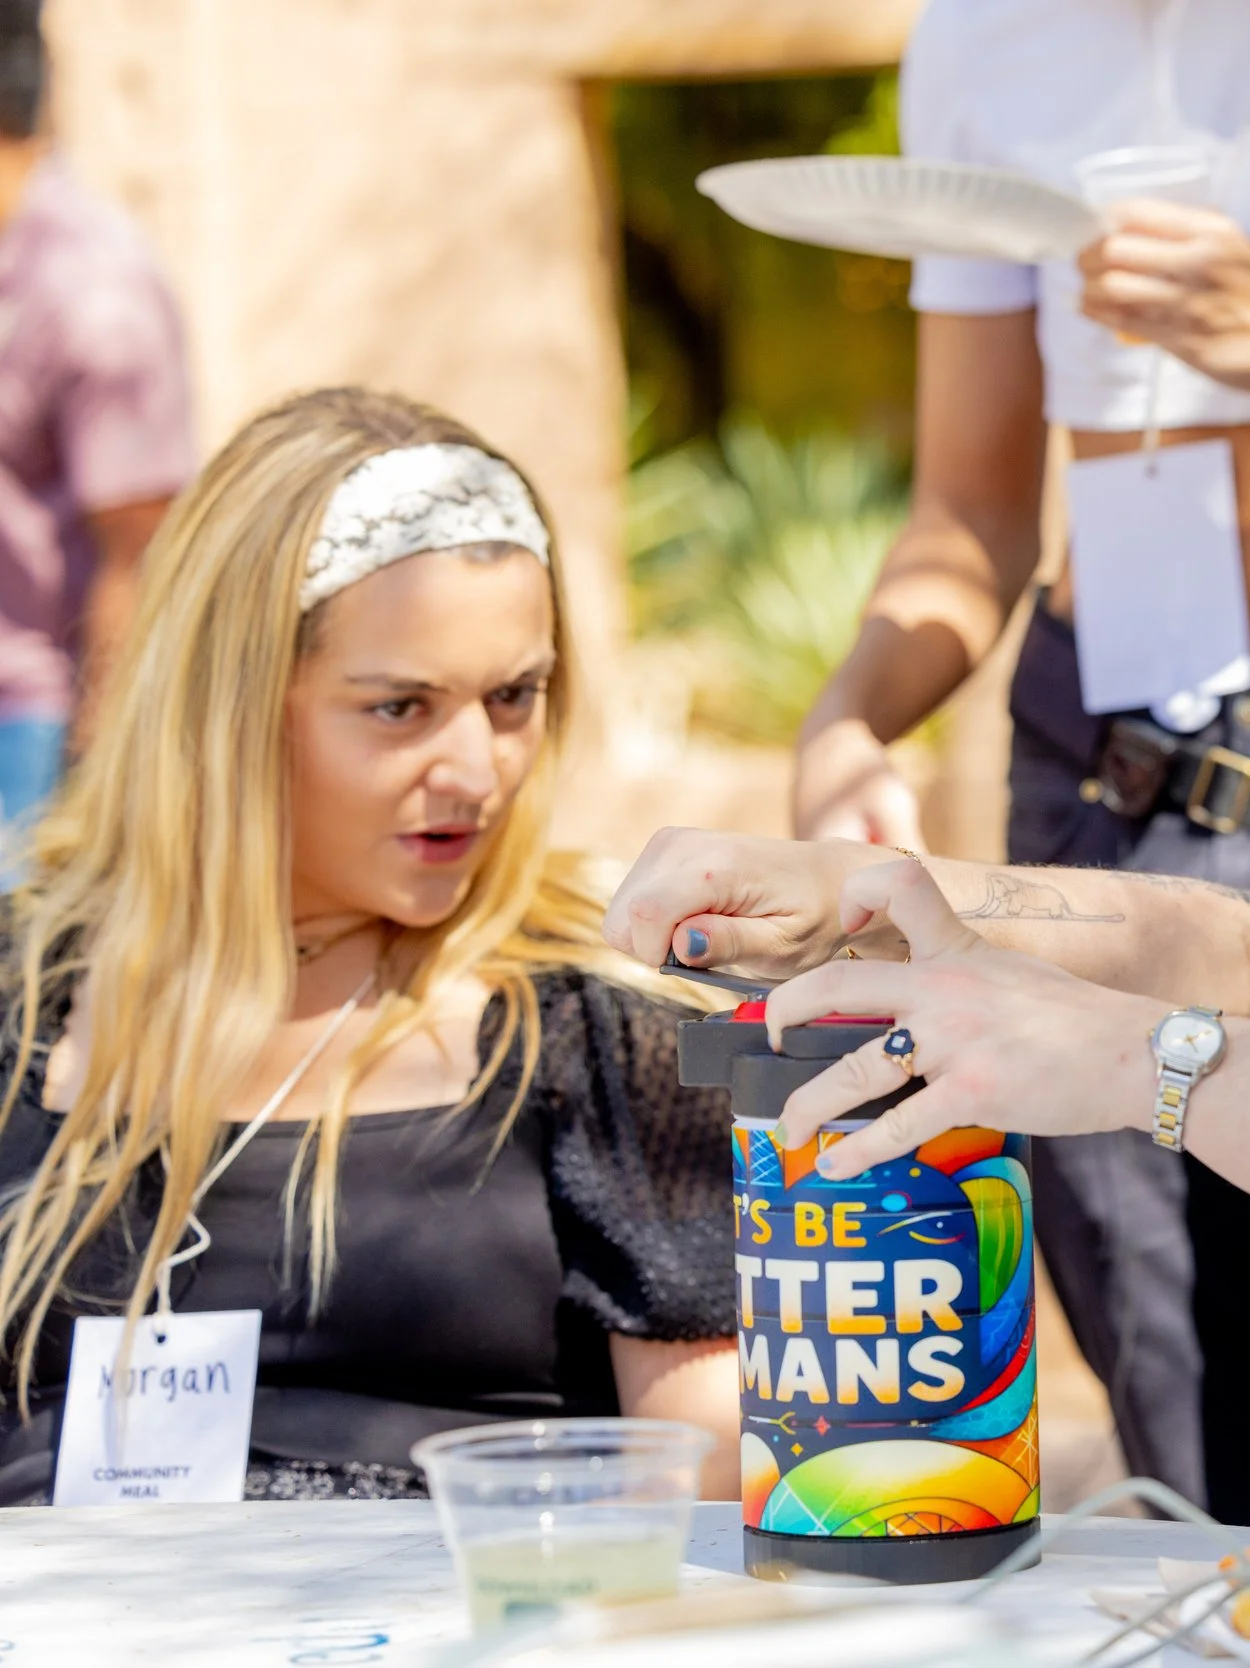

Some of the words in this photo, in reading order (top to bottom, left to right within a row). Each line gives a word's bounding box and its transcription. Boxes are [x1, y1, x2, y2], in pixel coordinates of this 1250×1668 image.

[794, 1201, 868, 1248] BE
[735, 1256, 964, 1335] TTER
[739, 1334, 966, 1405] MANS
[93, 1465, 192, 1481] COMMUNITY
